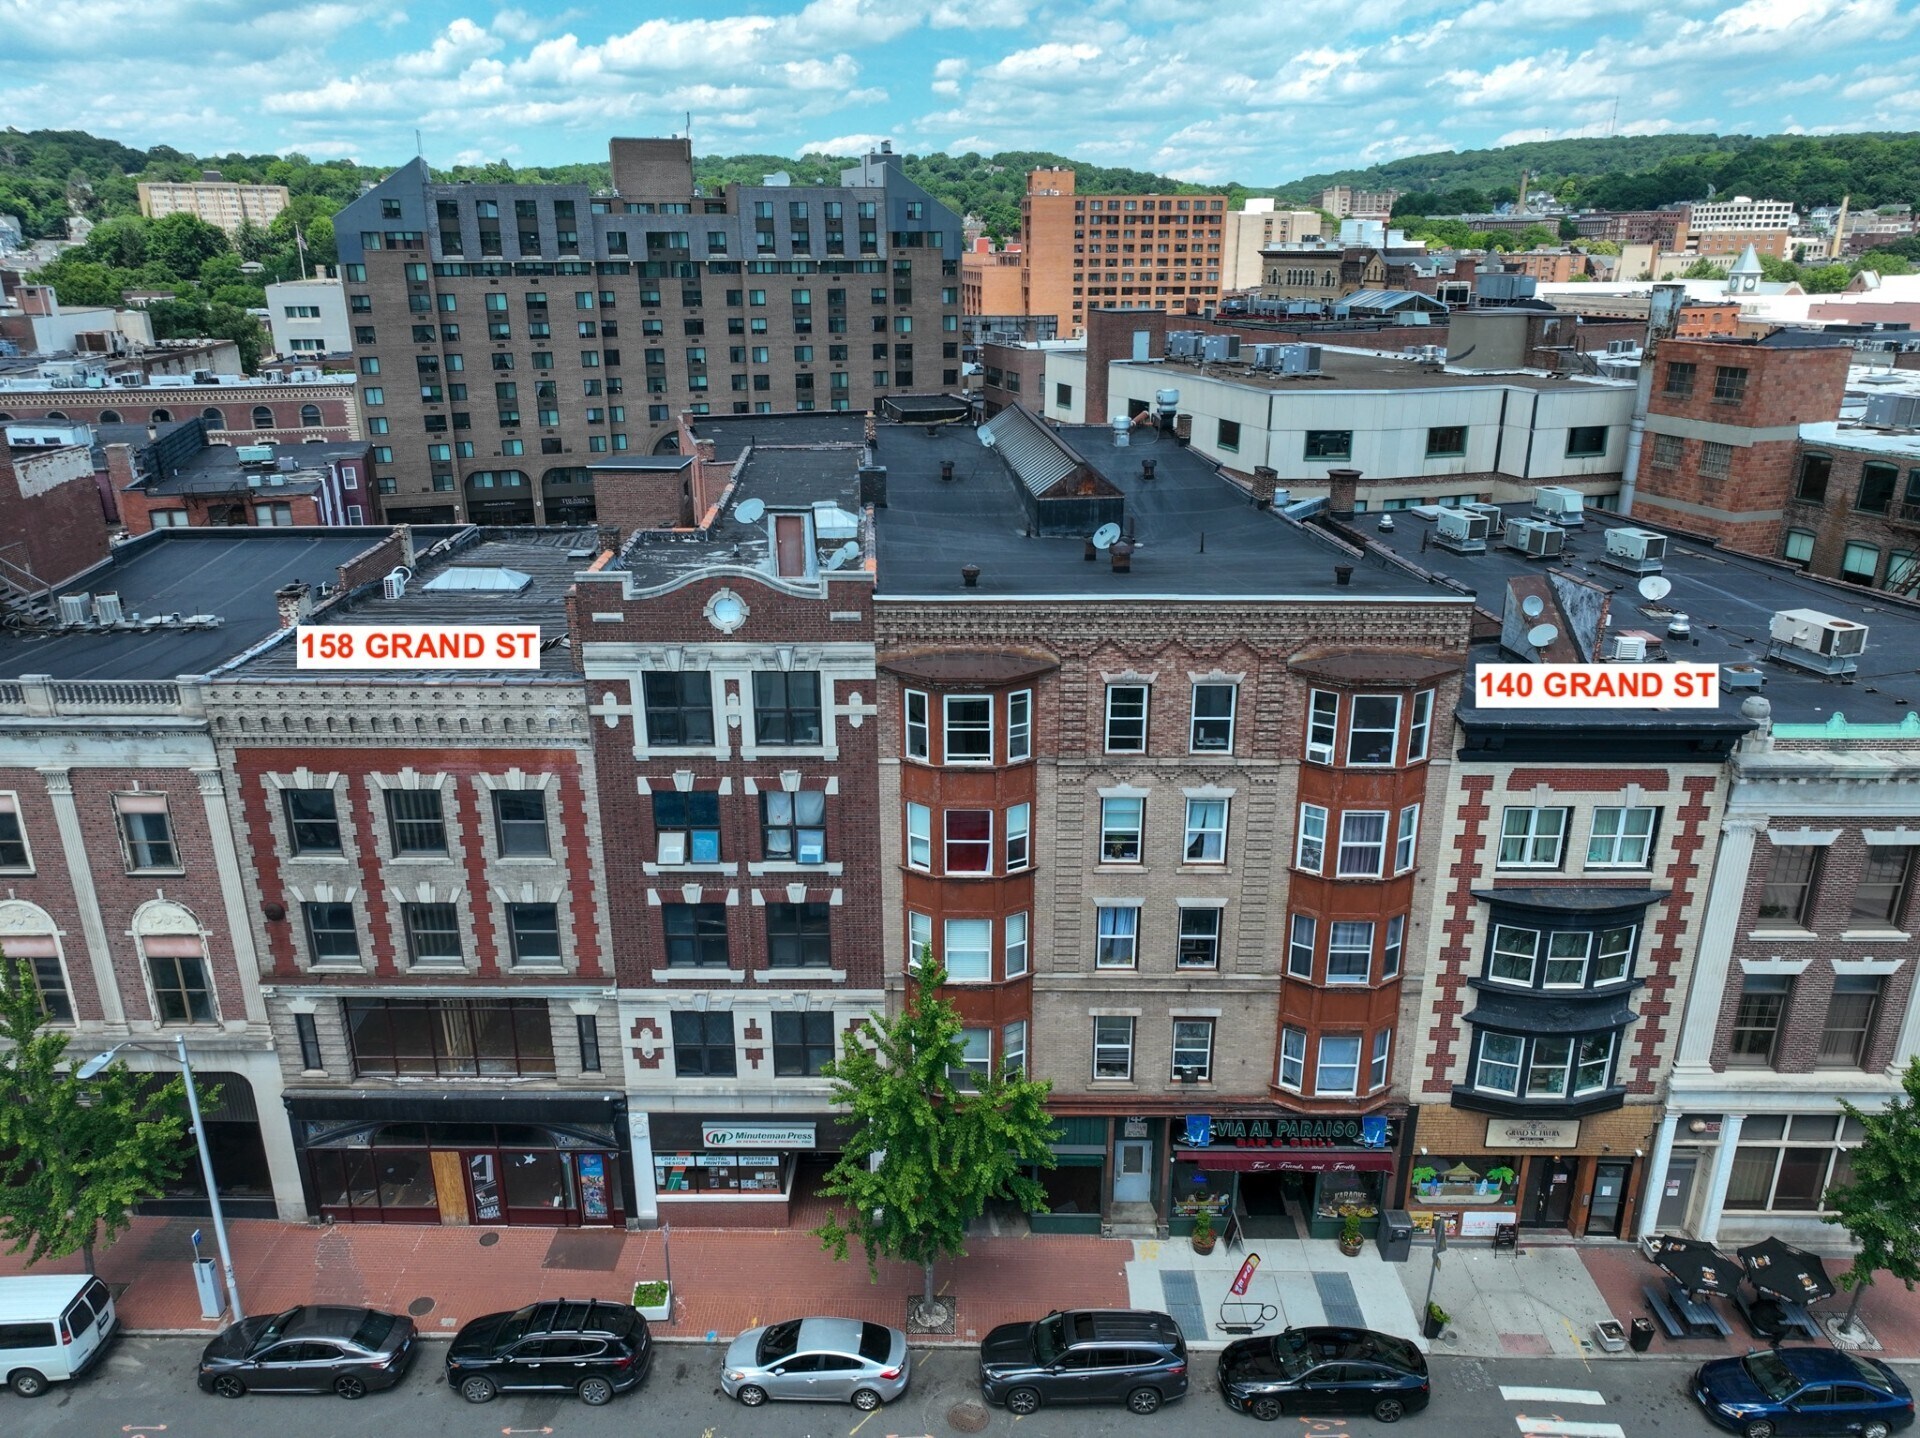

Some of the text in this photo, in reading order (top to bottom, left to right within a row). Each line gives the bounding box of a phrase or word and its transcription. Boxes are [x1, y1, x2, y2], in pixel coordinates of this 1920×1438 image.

[1216, 1120, 1359, 1137] VIA AL PARAISO
[735, 1132, 812, 1140] Minuteman Press
[1236, 1138, 1267, 1148] BAR
[1289, 1138, 1335, 1148] GRILL
[1334, 1191, 1367, 1199] KARAOKE
